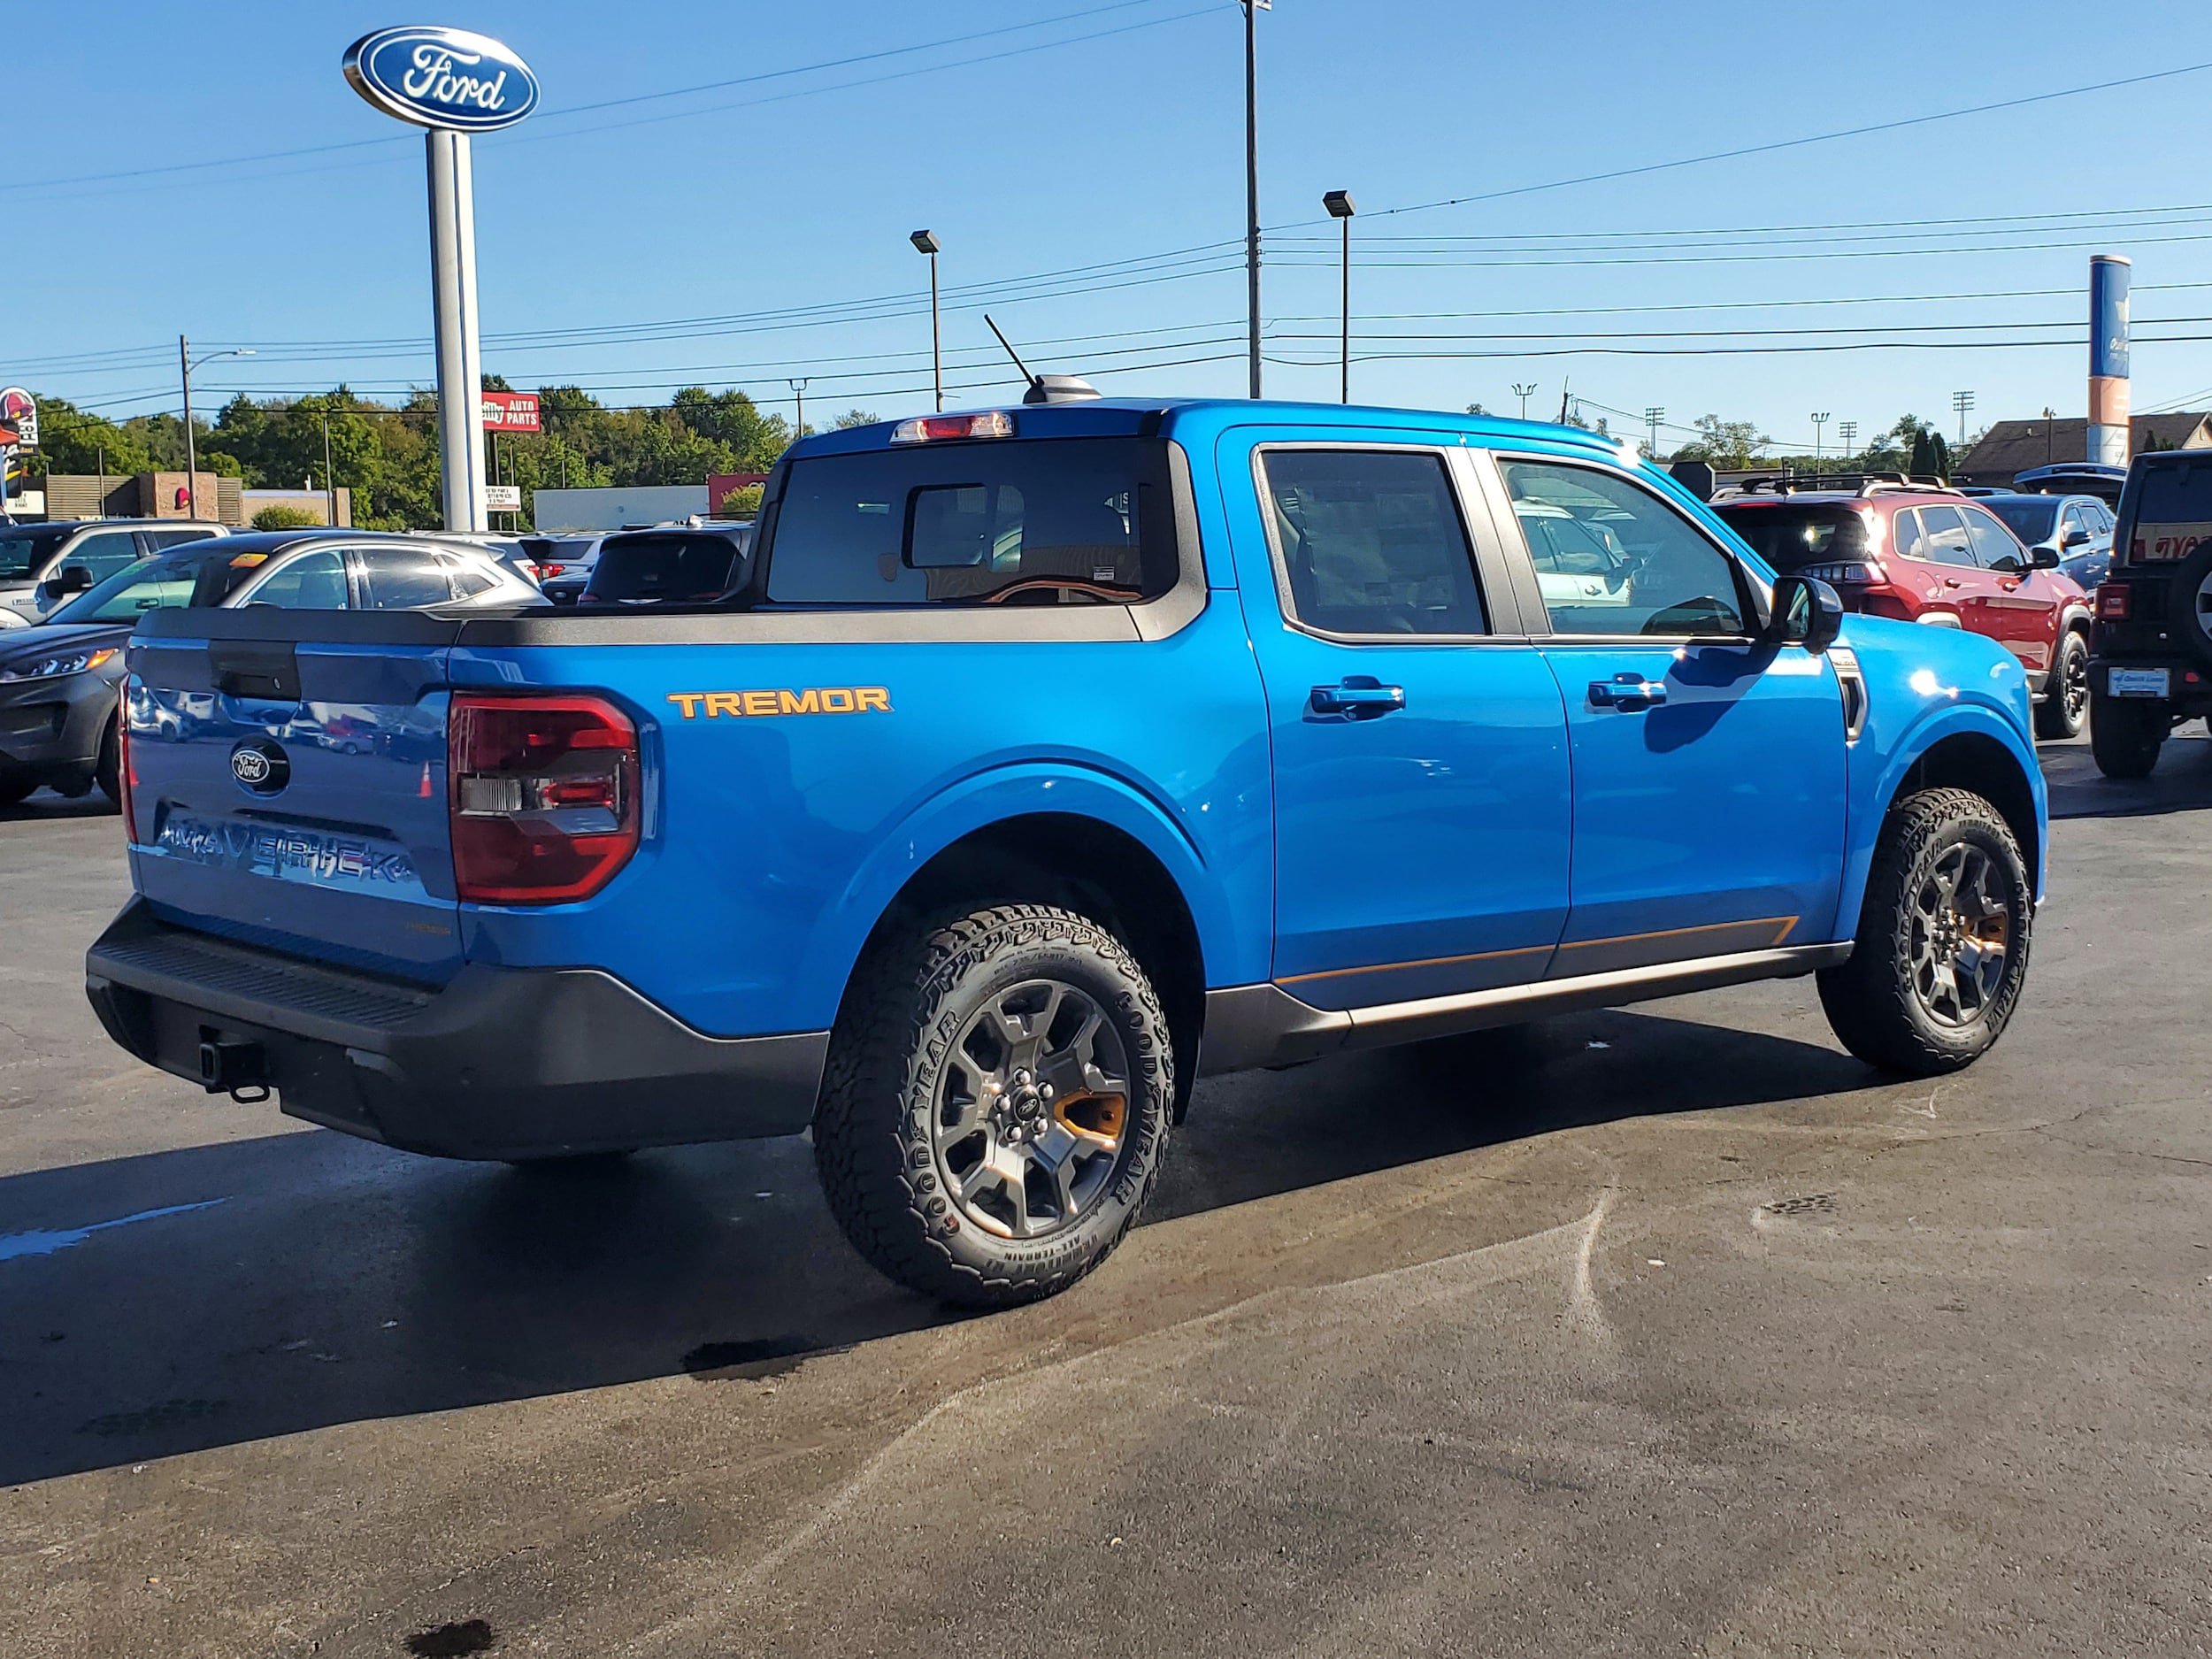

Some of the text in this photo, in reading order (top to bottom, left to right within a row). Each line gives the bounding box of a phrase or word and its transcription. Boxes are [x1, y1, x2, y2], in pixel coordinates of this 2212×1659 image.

[403, 45, 507, 110] Ford
[507, 413, 537, 425] PARTS
[509, 400, 534, 411] AUTO
[666, 686, 895, 719] TREMOR
[237, 754, 262, 778] Ford
[163, 825, 398, 883] MAVERICK
[1116, 991, 1161, 1206] GOODYEAR
[909, 1009, 961, 1237] GOODYEAR
[1004, 1234, 1081, 1262] ALL-TERRAIN
